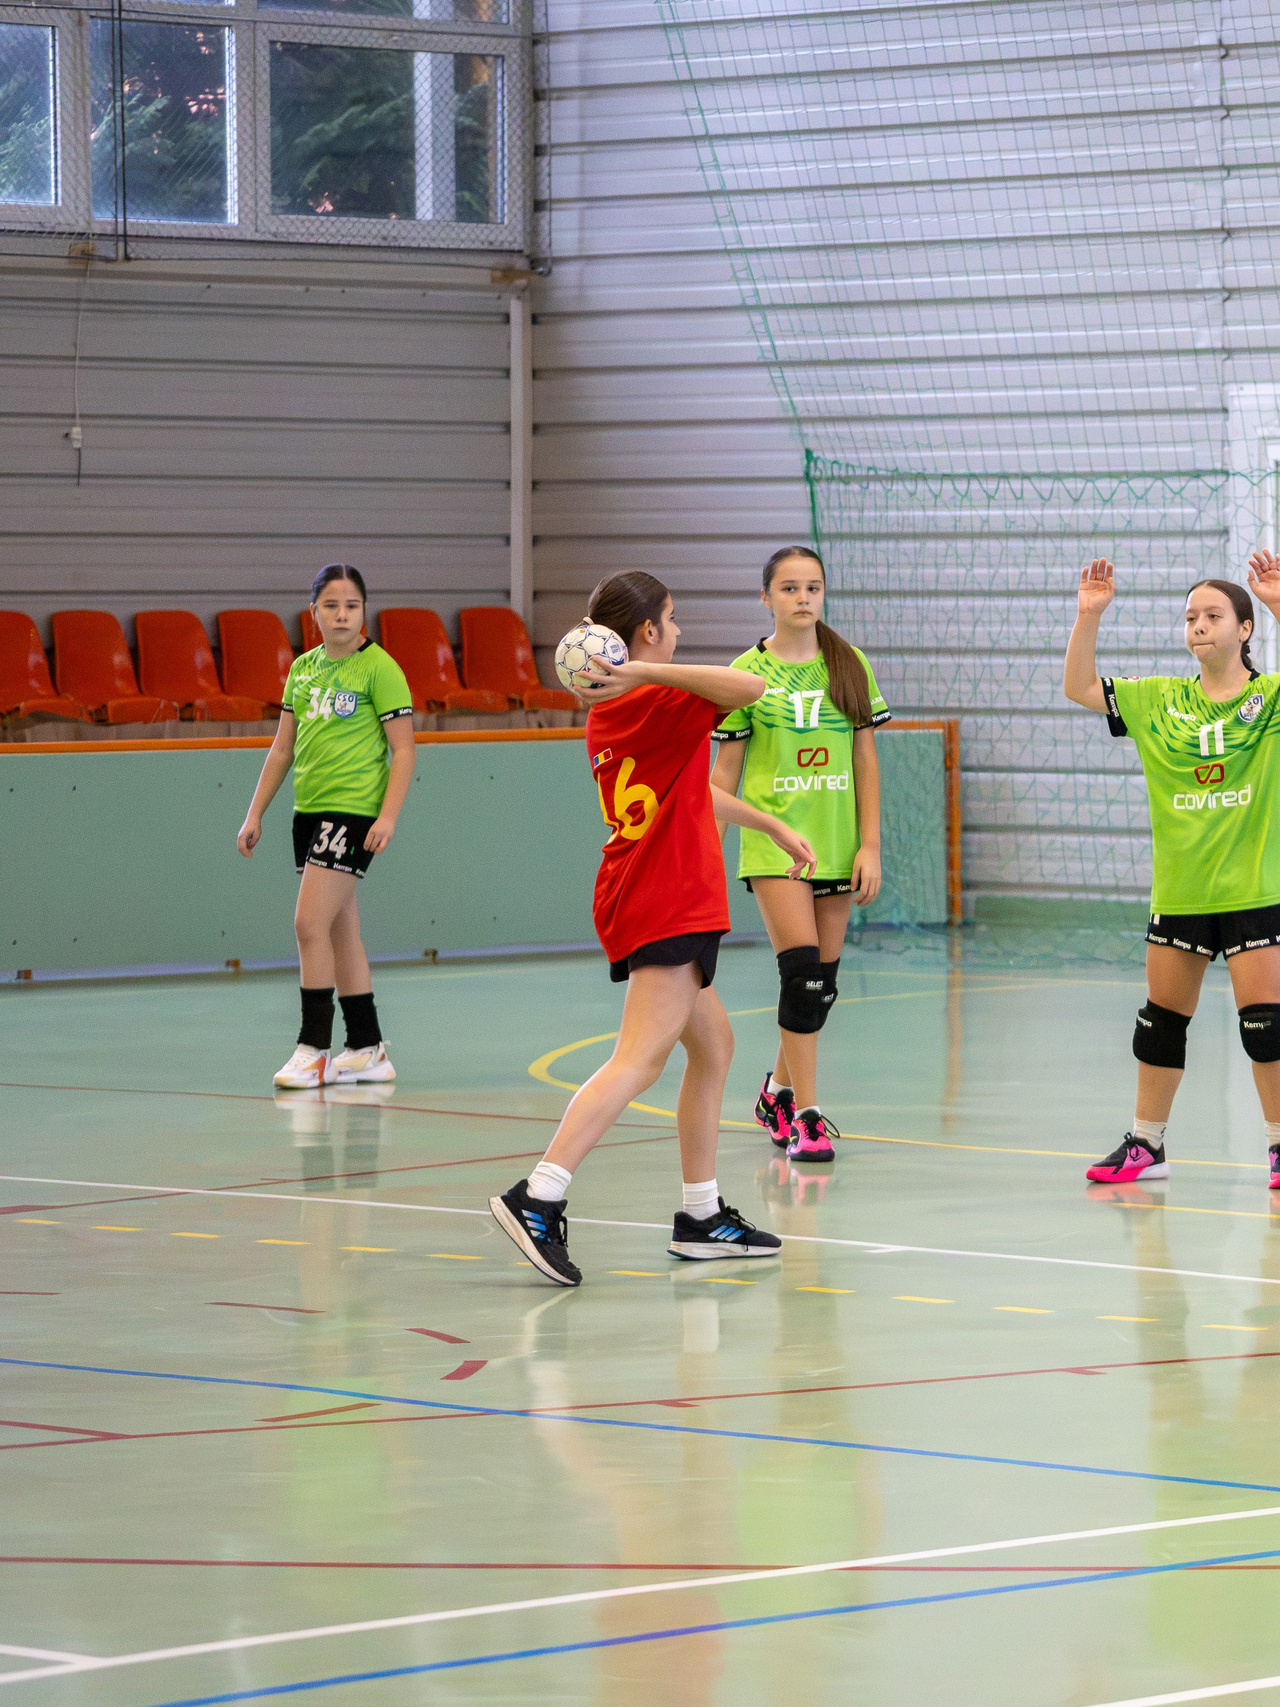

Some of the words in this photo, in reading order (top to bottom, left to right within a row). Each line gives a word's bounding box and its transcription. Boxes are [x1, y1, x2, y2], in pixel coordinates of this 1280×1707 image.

[306, 687, 332, 720] 34
[788, 689, 825, 728] 17
[1108, 693, 1120, 718] Kempa
[1166, 707, 1197, 722] Kempa
[773, 770, 849, 792] covired
[598, 757, 660, 841] 6
[1173, 785, 1251, 810] covired
[313, 820, 348, 860] 34
[333, 863, 353, 872] Kempa
[1149, 932, 1168, 944] Kempa
[1173, 938, 1192, 950] Kempa
[1245, 938, 1270, 949] Kempa
[1225, 945, 1241, 955] Kempa
